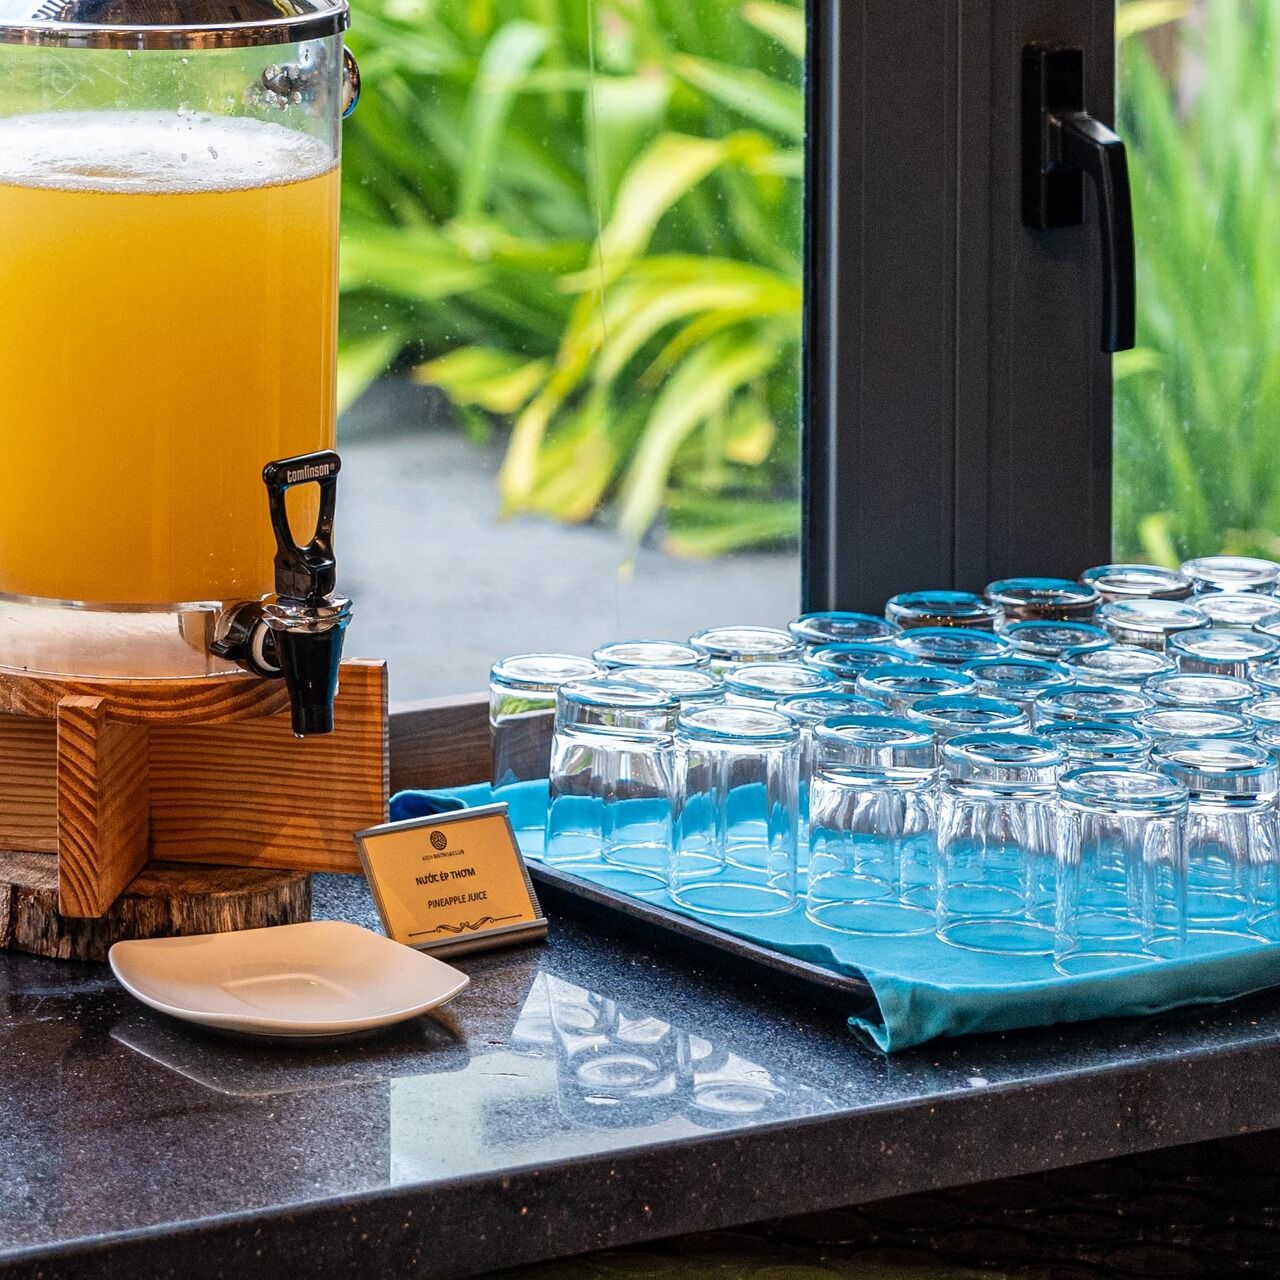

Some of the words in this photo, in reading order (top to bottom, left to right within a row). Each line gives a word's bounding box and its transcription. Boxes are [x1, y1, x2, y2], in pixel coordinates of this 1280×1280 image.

[449, 867, 476, 880] THƠM
[427, 894, 467, 910] PINEAPPLE
[467, 890, 488, 902] JUICE
